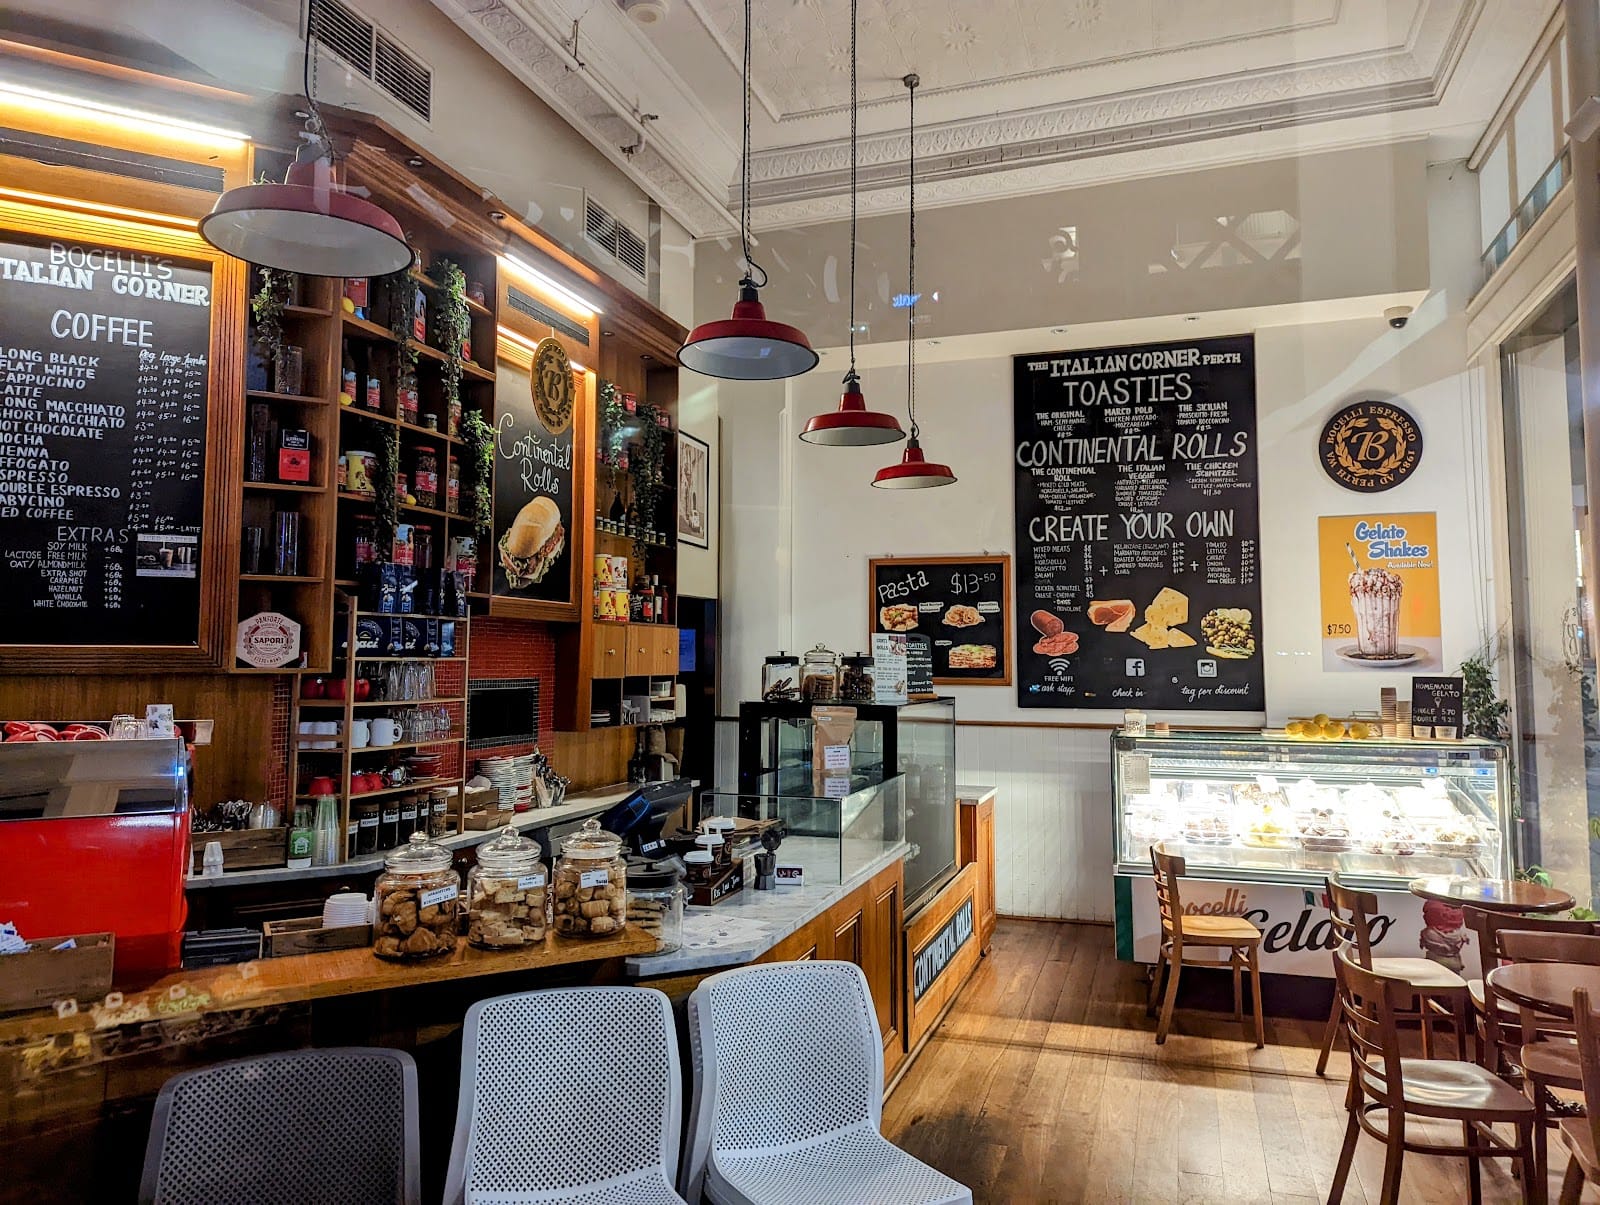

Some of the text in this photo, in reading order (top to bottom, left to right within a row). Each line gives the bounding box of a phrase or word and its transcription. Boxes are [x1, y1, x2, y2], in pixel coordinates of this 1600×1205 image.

[50, 242, 173, 280] BOCELLI'S
[111, 275, 210, 306] CORNER
[50, 309, 153, 348] COFFEE
[0, 347, 100, 368] LONG BLACK
[1027, 348, 1241, 378] THE ITALIAN CORNER PERTH
[0, 360, 35, 373] FLAT
[45, 365, 96, 380] WHITE
[0, 371, 86, 390] CAPPUCINO
[1062, 372, 1193, 407] TOASTIES
[0, 397, 37, 410] ONG
[46, 400, 126, 418] MACCHIATO
[1104, 406, 1153, 416] MARCO POLO
[1178, 402, 1228, 412] THE SICILIAN
[0, 407, 125, 430] HORT MACCHIATO
[1035, 410, 1085, 420] THE ORIGINAL
[1105, 415, 1131, 423] CHICKEN
[25, 422, 104, 440] CHOCOLATE
[1326, 406, 1416, 444] BOCELLI ESPRESSO
[498, 413, 570, 471] Continental
[1016, 432, 1248, 468] CONTINENTAL ROLLS
[1031, 466, 1096, 476] THE CONTINENTAL
[1118, 464, 1166, 472] THE ITALIAN
[1195, 469, 1238, 477] SCHNITZEL
[1204, 462, 1239, 470] CHICKEN
[1327, 450, 1416, 487] 1989 AD PERTH WA
[520, 458, 559, 494] Rolls
[1128, 472, 1155, 480] VEGGIE
[51, 484, 120, 499] ESPRESSO
[26, 508, 74, 521] COFFEE
[1028, 509, 1234, 542] CREATE YOUR OWN
[1355, 521, 1406, 541] Gelato
[57, 526, 129, 544] EXTRAS
[47, 542, 88, 551] SOY MILK
[1052, 545, 1071, 553] MEATS
[1368, 541, 1428, 559] Shakes
[4, 550, 87, 560] LACTOSE FREE MILK
[1387, 561, 1417, 569] Available
[41, 569, 87, 578] EXTRA SHOT
[50, 577, 84, 585] CARAMEL
[48, 585, 83, 593] HAZELNUT
[33, 600, 54, 608] WHITE
[54, 593, 82, 601] VANILLA
[1041, 682, 1076, 696] ask staff
[1112, 685, 1144, 698] check in
[1181, 683, 1249, 703] tag for discount
[1432, 690, 1460, 698] GELATO
[1413, 707, 1436, 715] SINGLE
[1238, 908, 1397, 955] Gelao
[914, 901, 972, 1000] CONTINENTAL ROLLS
